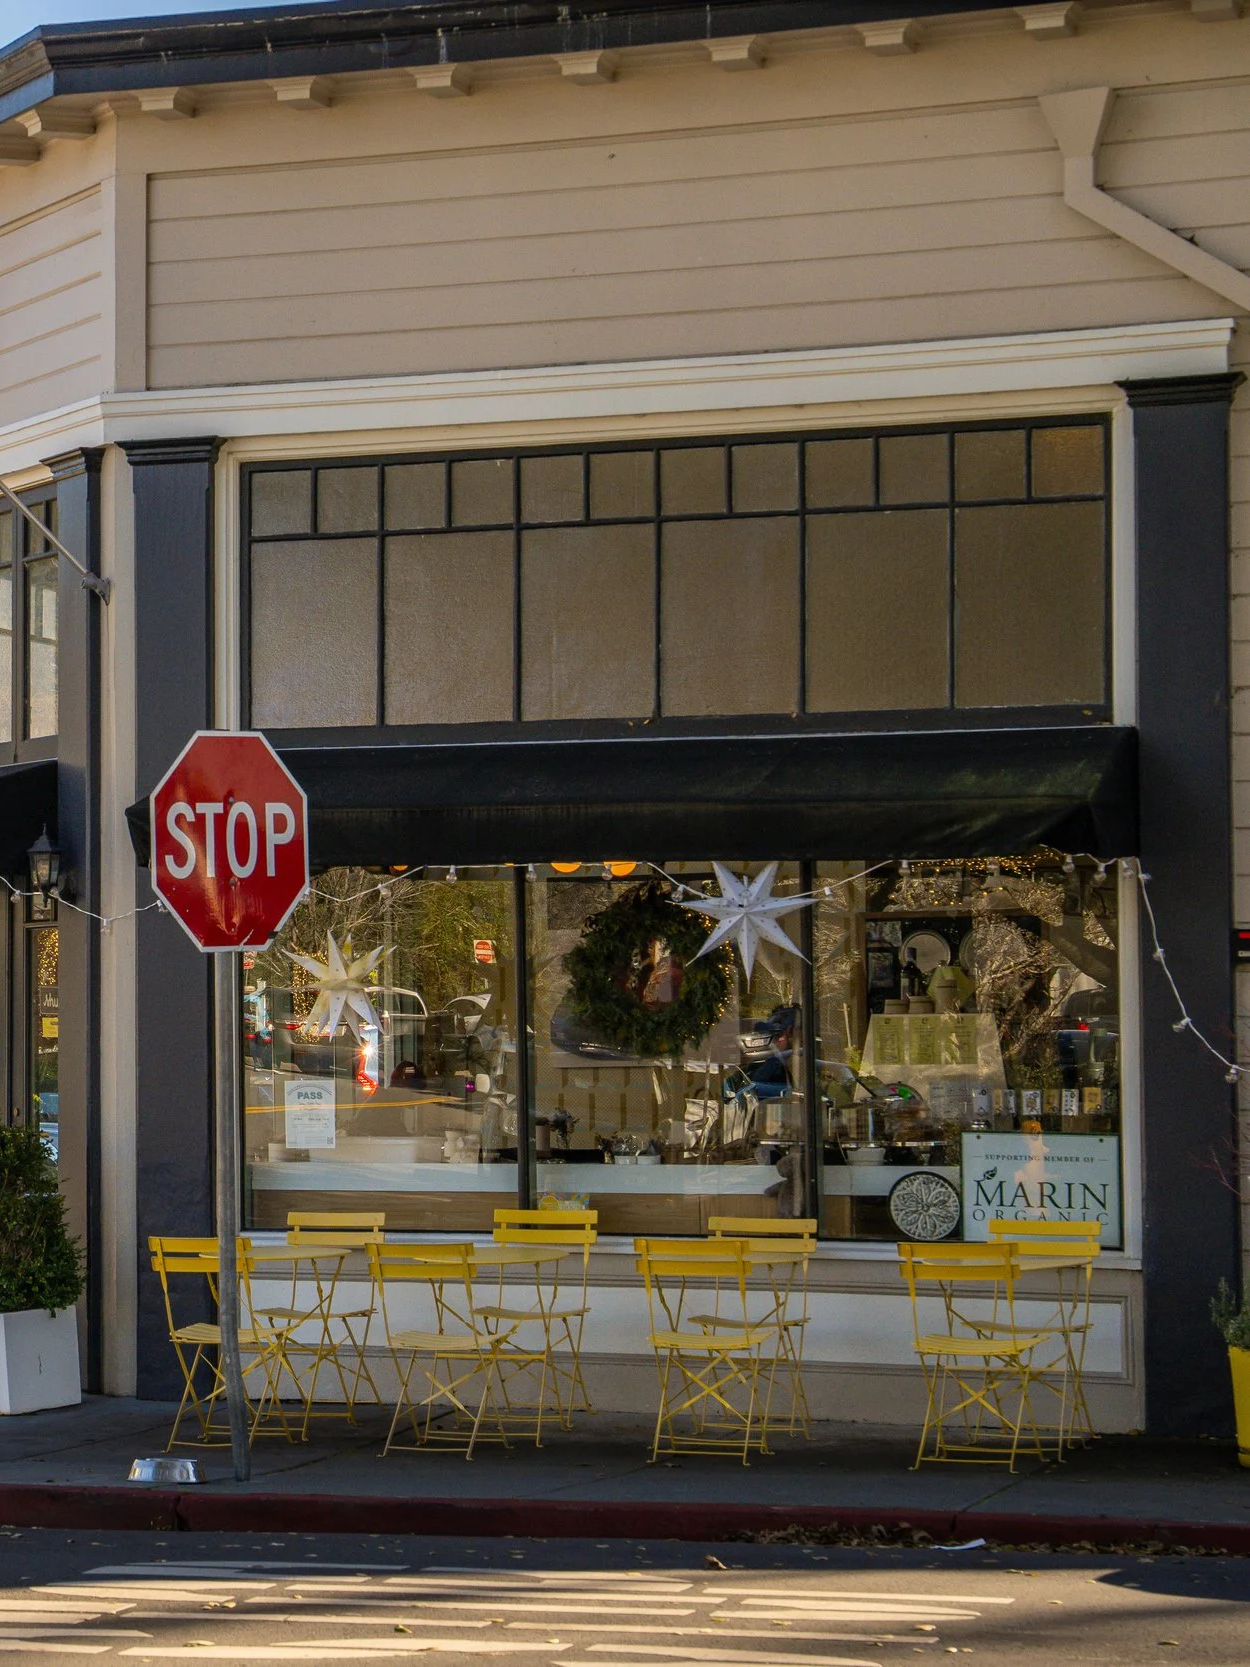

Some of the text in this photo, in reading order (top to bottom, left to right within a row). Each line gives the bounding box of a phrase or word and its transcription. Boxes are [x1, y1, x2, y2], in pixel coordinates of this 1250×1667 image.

[164, 801, 296, 880] STOP
[297, 1091, 323, 1100] PASS
[973, 1179, 1110, 1211] MARIN
[972, 1208, 1109, 1225] ORGANIC
